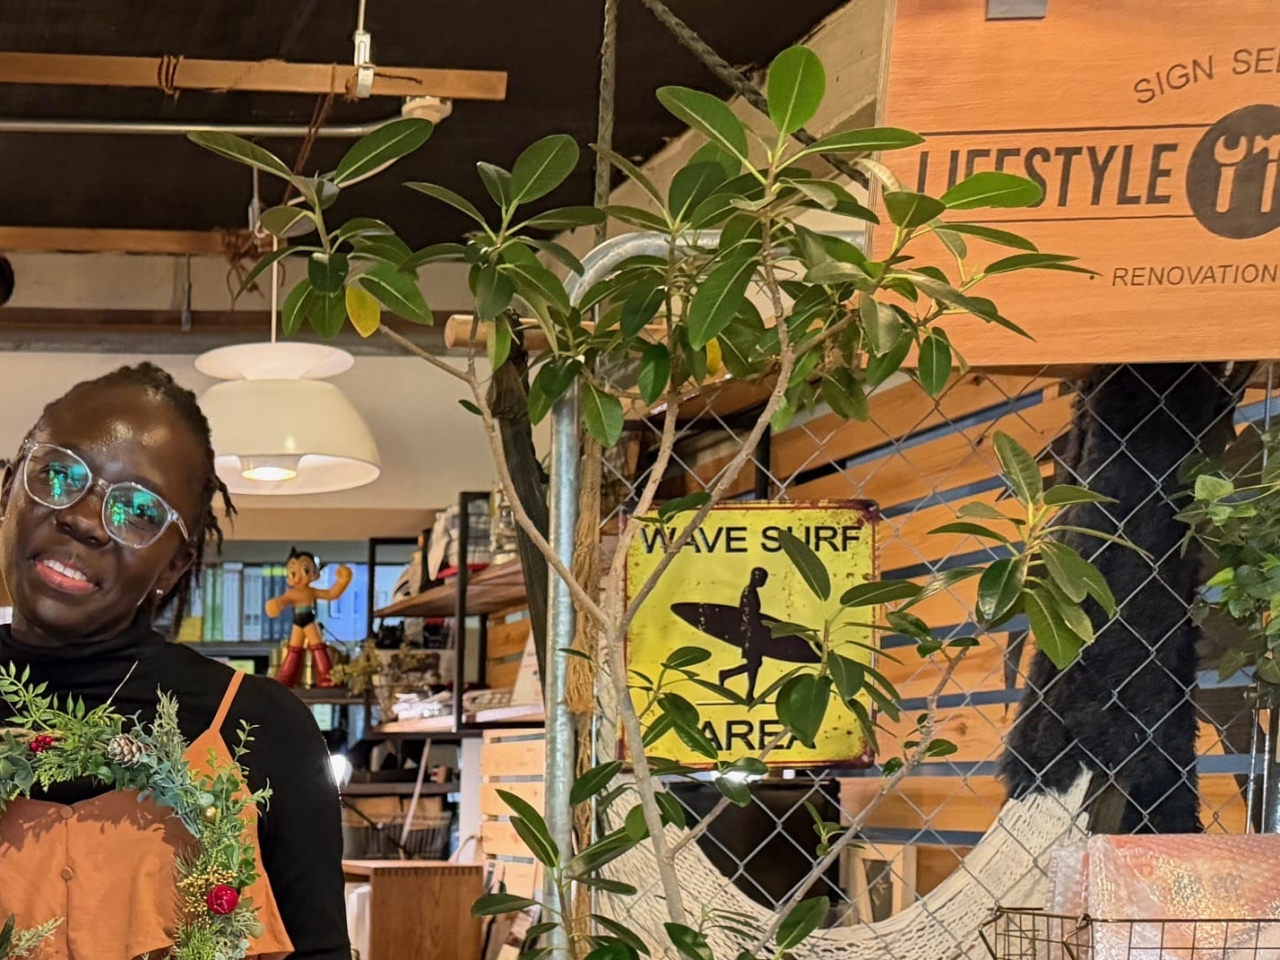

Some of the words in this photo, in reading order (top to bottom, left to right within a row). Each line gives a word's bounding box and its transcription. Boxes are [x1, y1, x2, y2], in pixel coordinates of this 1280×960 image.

[1133, 55, 1214, 104] SIGN
[1111, 264, 1278, 287] RENOVATION
[640, 526, 748, 554] WAVE
